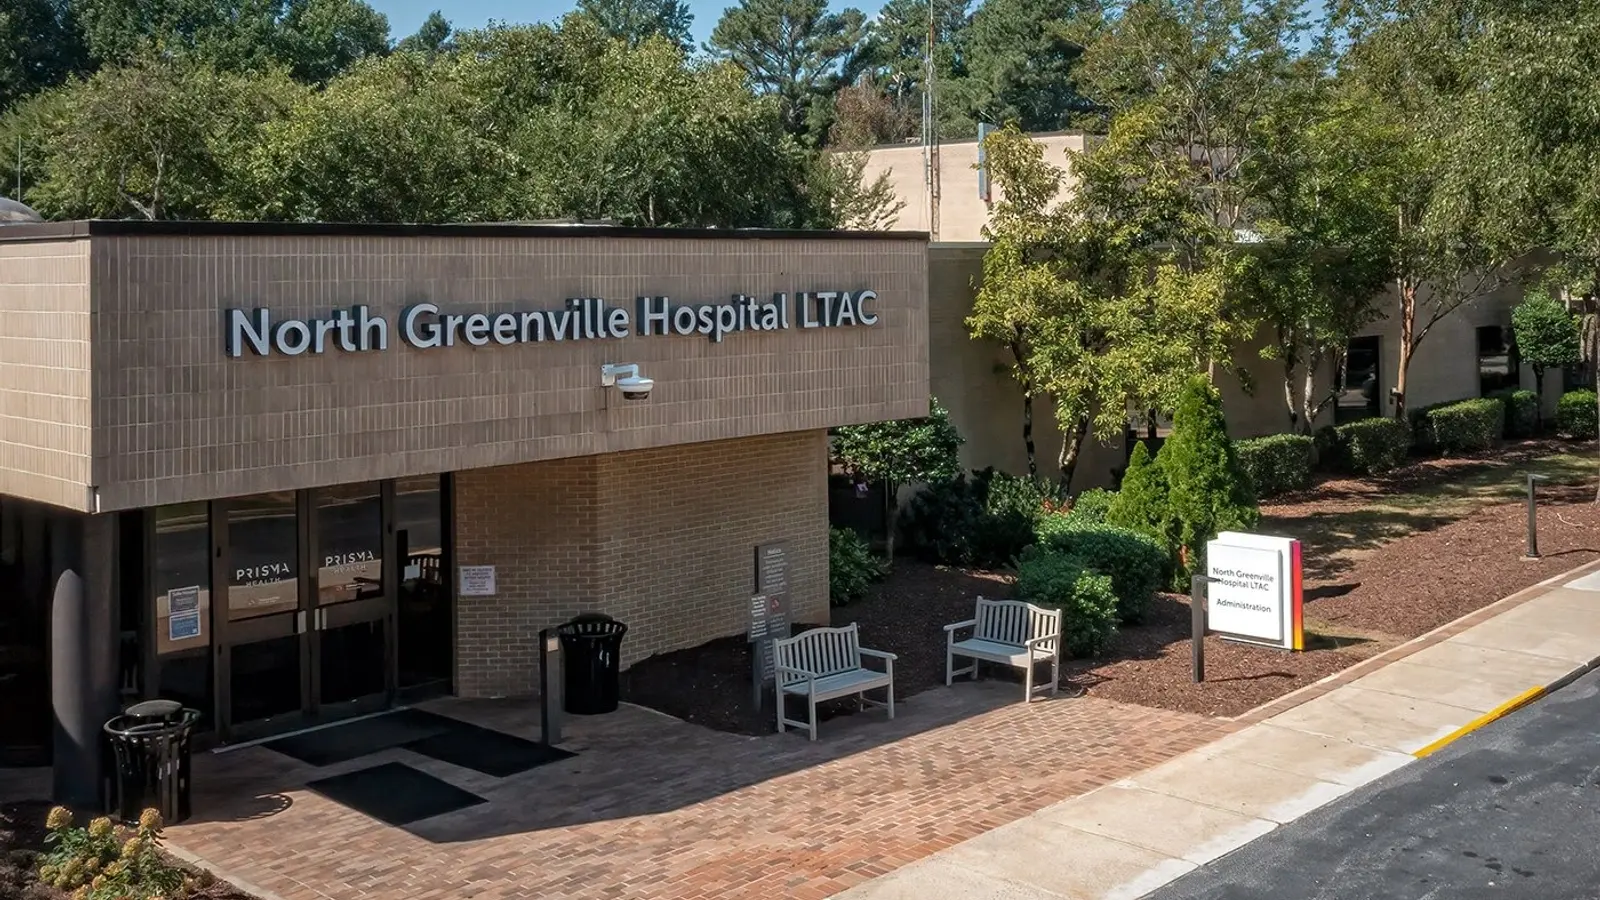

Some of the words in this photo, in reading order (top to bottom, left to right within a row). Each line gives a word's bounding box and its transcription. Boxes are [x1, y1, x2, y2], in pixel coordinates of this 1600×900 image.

[226, 305, 388, 357] North
[398, 297, 630, 349] Greenville
[636, 292, 790, 343] Hospital
[796, 289, 879, 329] LTAC
[325, 551, 373, 566] PRISMA
[236, 563, 290, 580] PRISMA
[1212, 567, 1235, 577] North
[1236, 570, 1274, 582] Greenville
[246, 577, 281, 587] HEALTH
[1218, 578, 1249, 588] Hospital
[1250, 582, 1269, 591] LTAC
[1216, 598, 1271, 612] Administration
